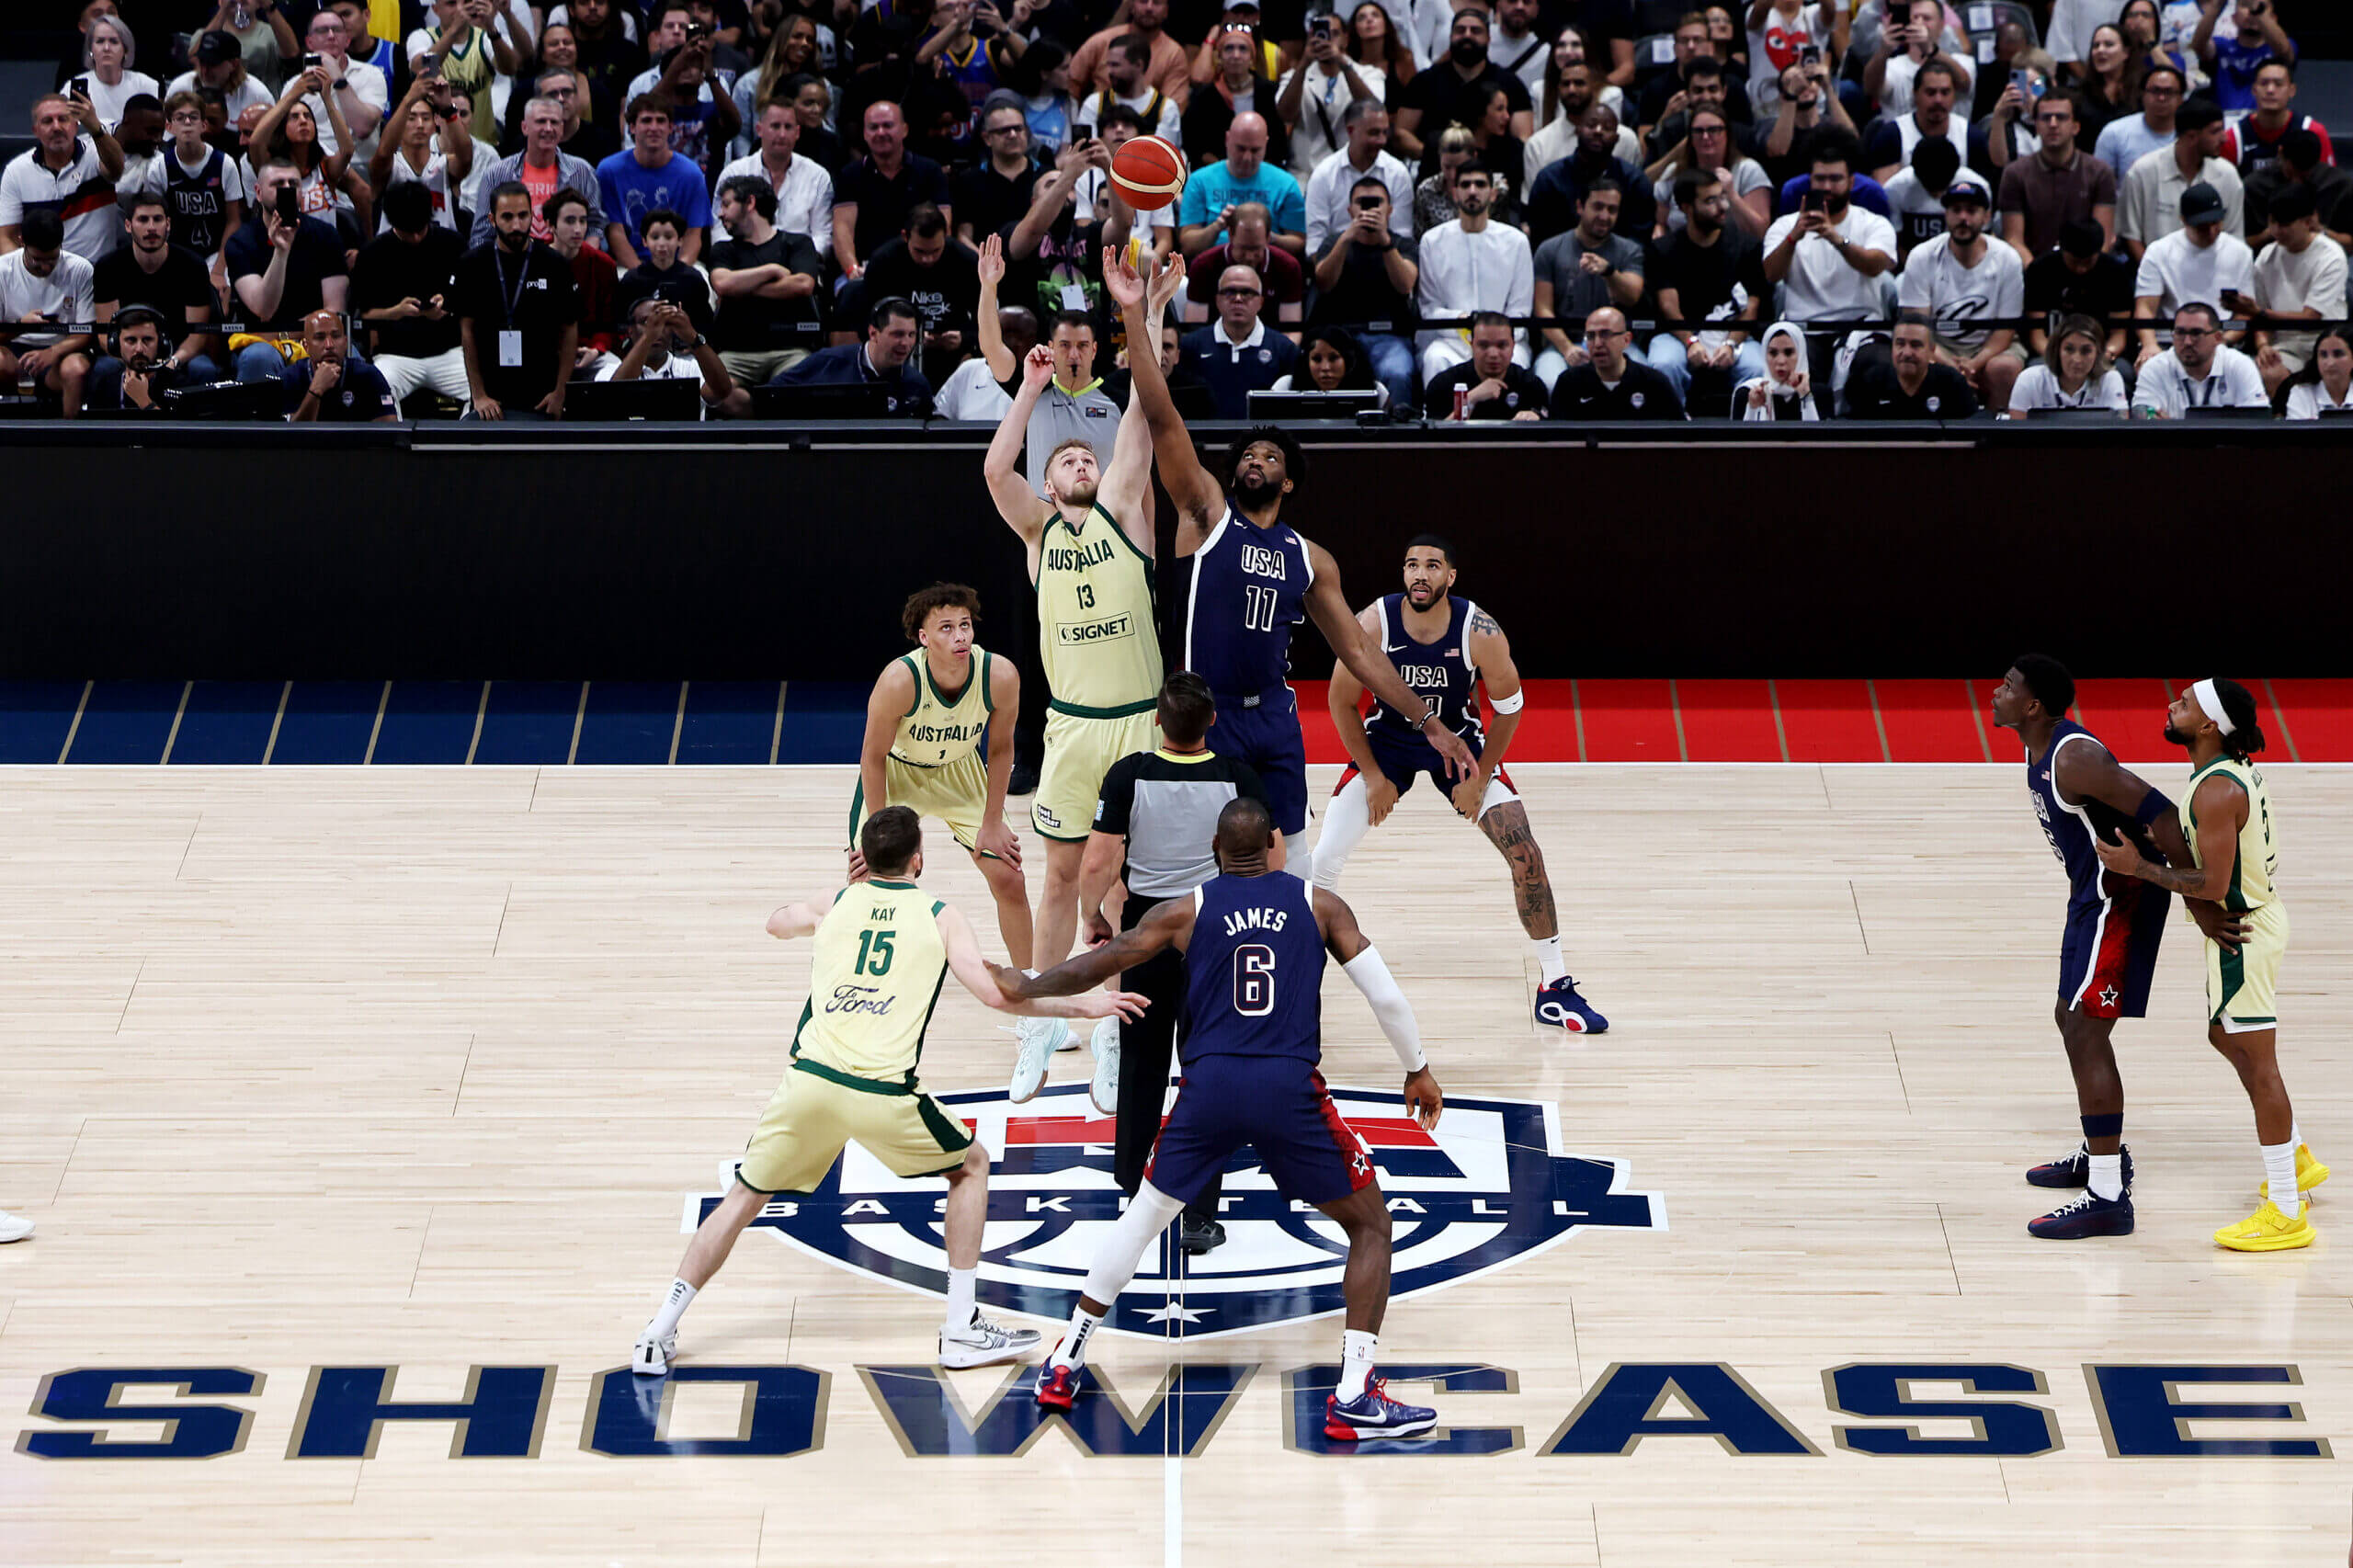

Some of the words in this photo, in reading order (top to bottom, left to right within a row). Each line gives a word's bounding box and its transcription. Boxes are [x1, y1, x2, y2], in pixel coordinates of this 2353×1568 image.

[175, 190, 218, 215] USA
[1913, 218, 1943, 237] US
[911, 290, 943, 304] Nike
[1048, 539, 1115, 573] AUSTRALIA
[1241, 544, 1287, 582] USA
[1075, 584, 1096, 609] 13
[1245, 585, 1278, 632] 11
[1073, 618, 1128, 642] SIGNET
[1401, 665, 1449, 687] USA
[908, 722, 983, 742] AUSTRALIA
[870, 906, 896, 922] KAY
[1223, 907, 1288, 937] JAMES
[854, 929, 897, 975] 15
[1233, 943, 1276, 1017] 6
[825, 984, 897, 1016] Ford
[756, 1197, 1589, 1218] BAKTALL
[14, 1361, 2336, 1460] SHOWCASE
